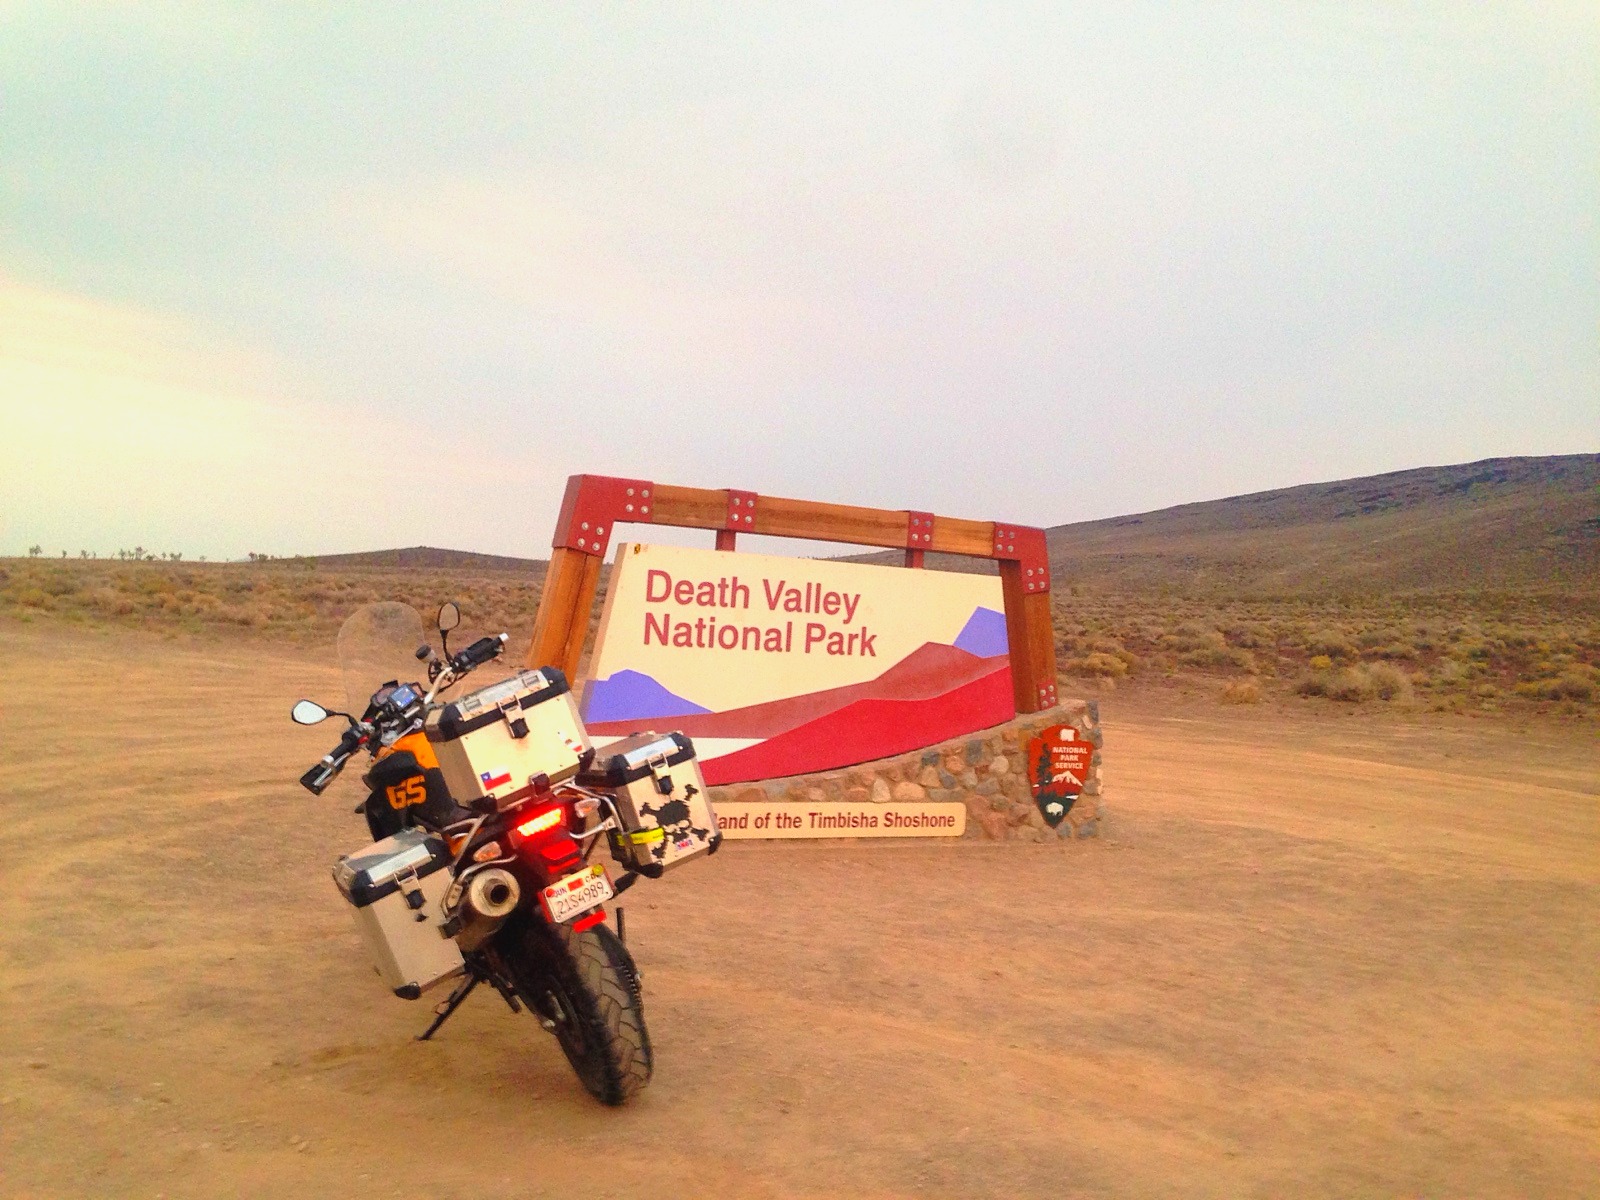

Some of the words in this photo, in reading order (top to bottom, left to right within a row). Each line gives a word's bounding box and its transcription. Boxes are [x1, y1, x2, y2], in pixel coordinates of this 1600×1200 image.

[645, 569, 750, 609] Death
[762, 578, 861, 625] Valley
[643, 612, 793, 652] National
[804, 622, 877, 657] Park
[1052, 746, 1088, 754] NATIONAL
[386, 775, 427, 810] GS
[754, 812, 771, 829] of
[776, 812, 802, 829] the
[808, 812, 879, 829] Timbisha
[883, 811, 956, 828] Shoshone
